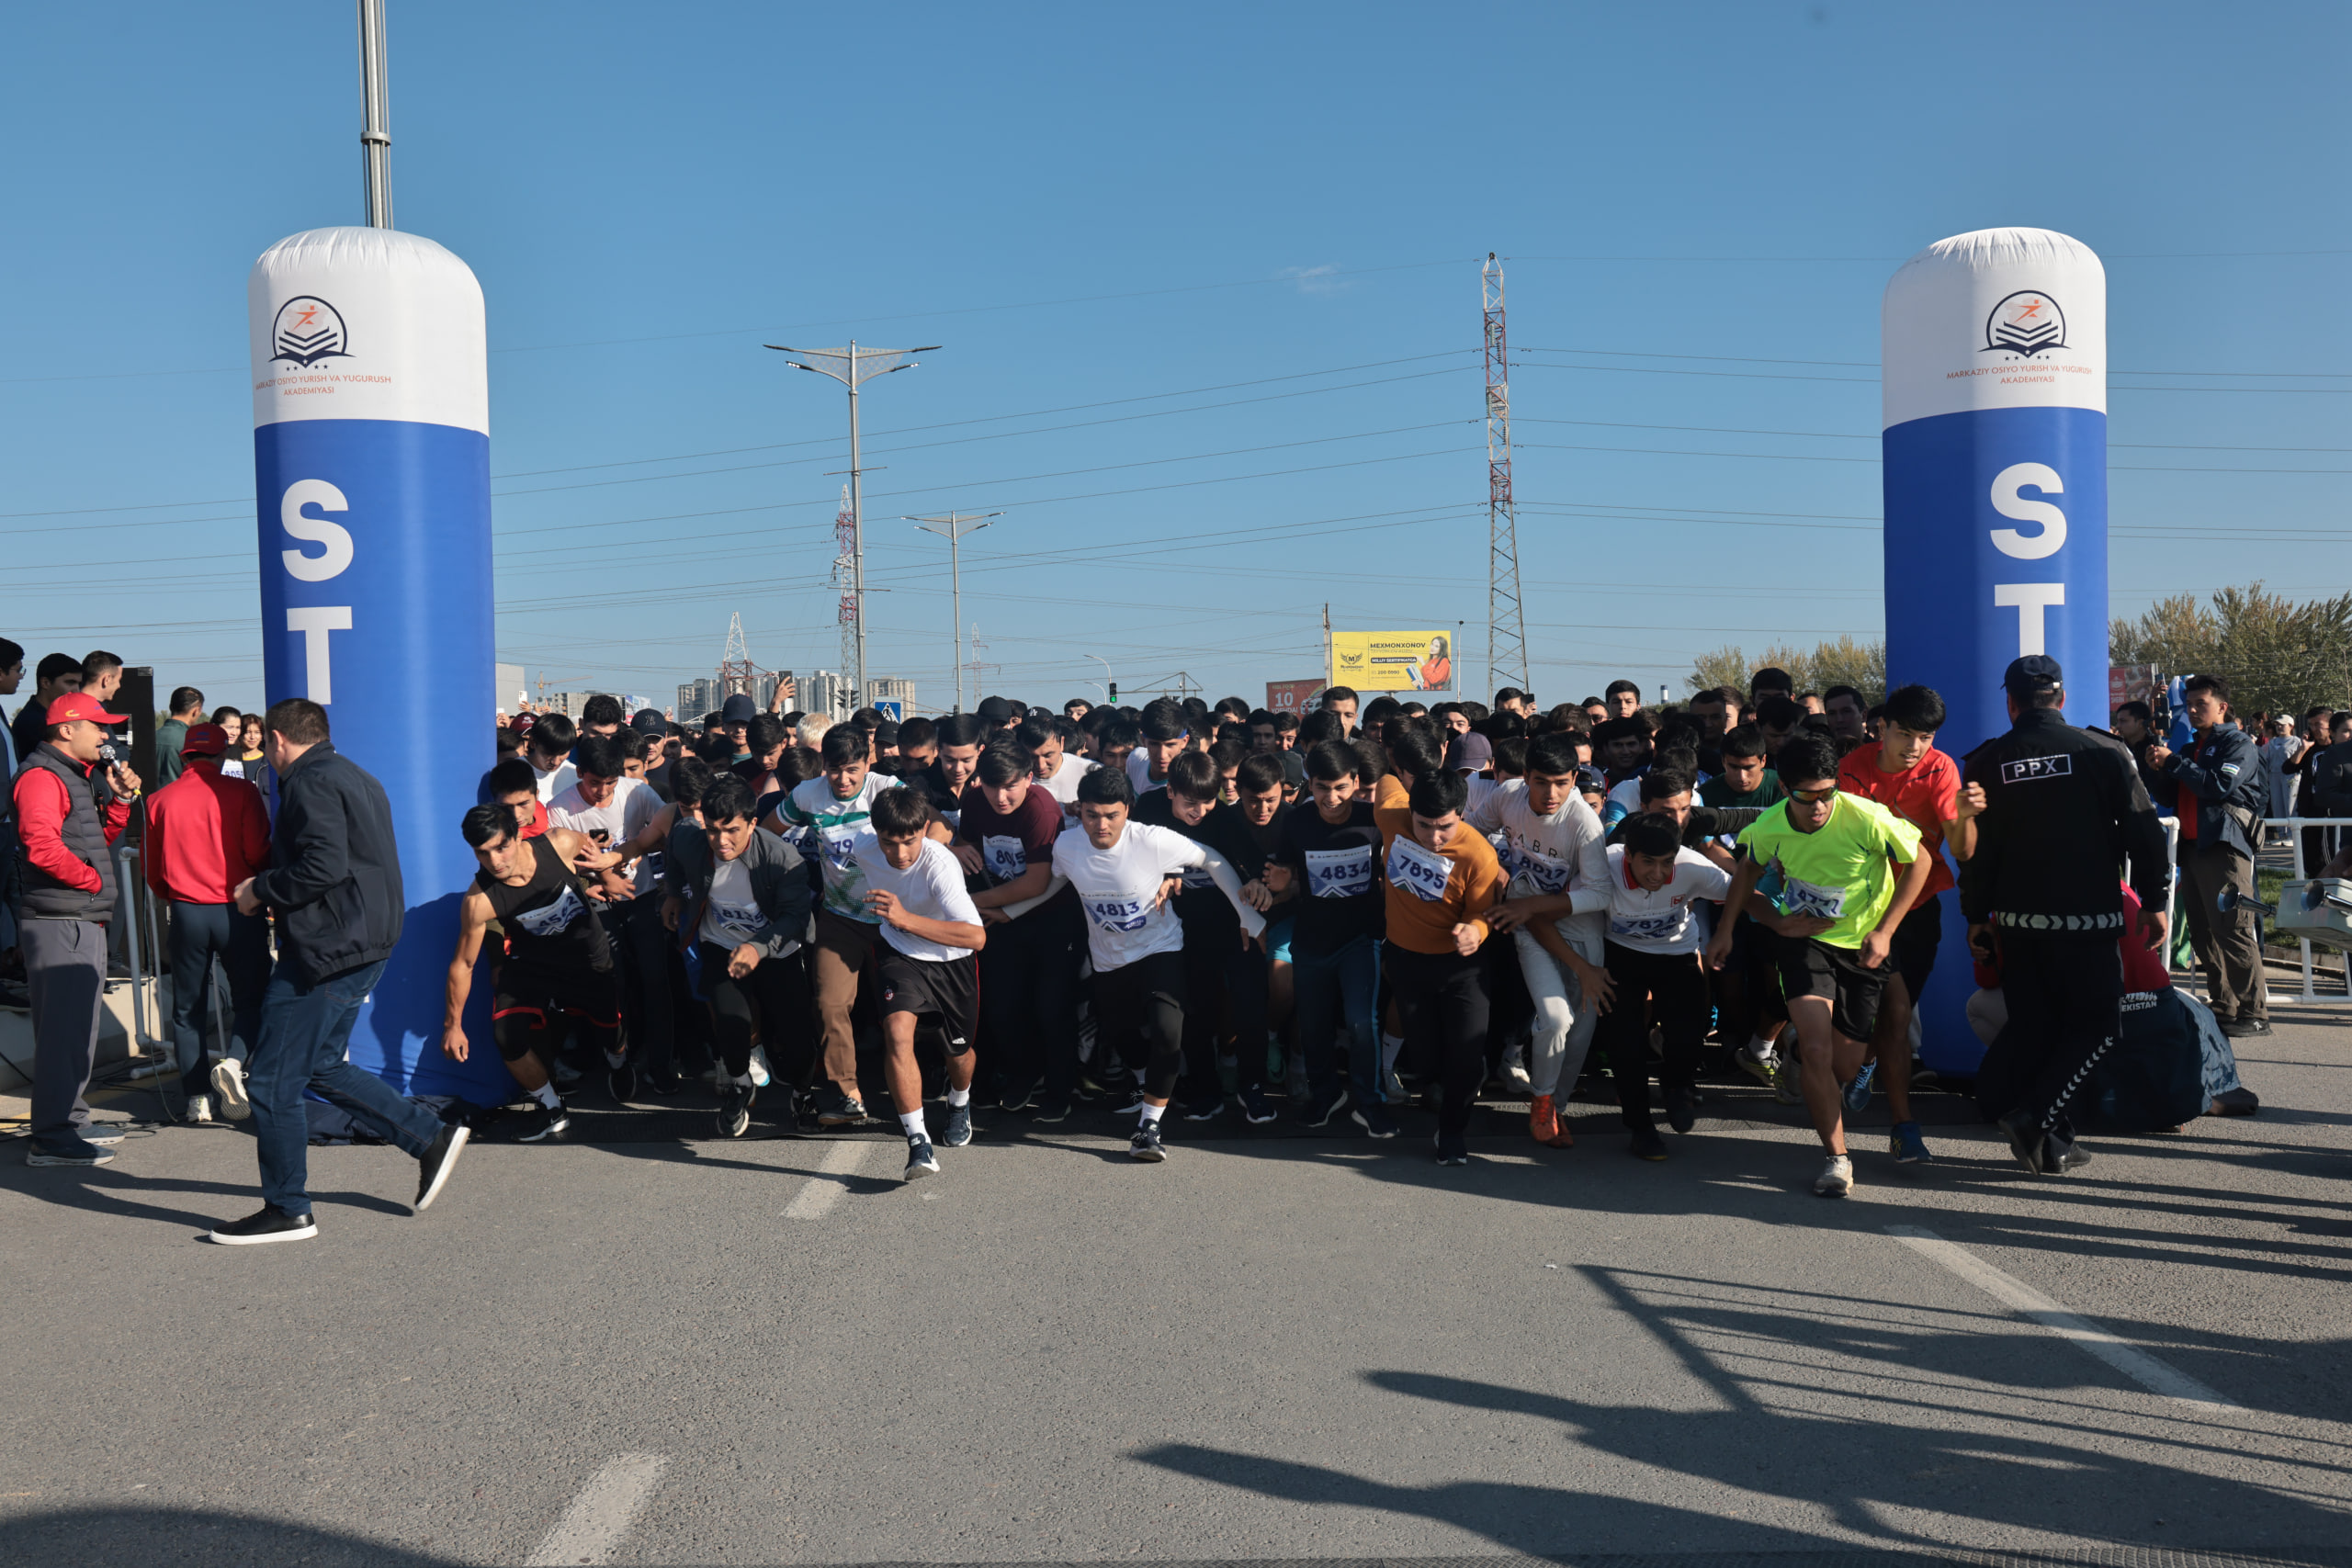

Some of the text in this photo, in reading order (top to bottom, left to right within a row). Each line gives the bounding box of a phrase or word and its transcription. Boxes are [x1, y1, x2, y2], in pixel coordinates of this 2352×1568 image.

[277, 376, 298, 385] OSIYO
[299, 375, 327, 383] YURISH
[329, 375, 341, 383] VA
[343, 375, 391, 384] YUGURUSH
[1946, 368, 1990, 379] MARKAZIY
[1991, 367, 2018, 375] OSIYO
[2000, 376, 2055, 384] AKADEMIYASI
[283, 386, 334, 396] AKADEMIYASI
[1275, 692, 1294, 707] 10
[2013, 759, 2057, 778] PPX
[1320, 860, 1370, 880] 4834
[1398, 854, 1446, 889] 7895
[1519, 856, 1566, 880] 8017
[1096, 901, 1140, 917] 4813
[1626, 915, 1677, 930] 7824
